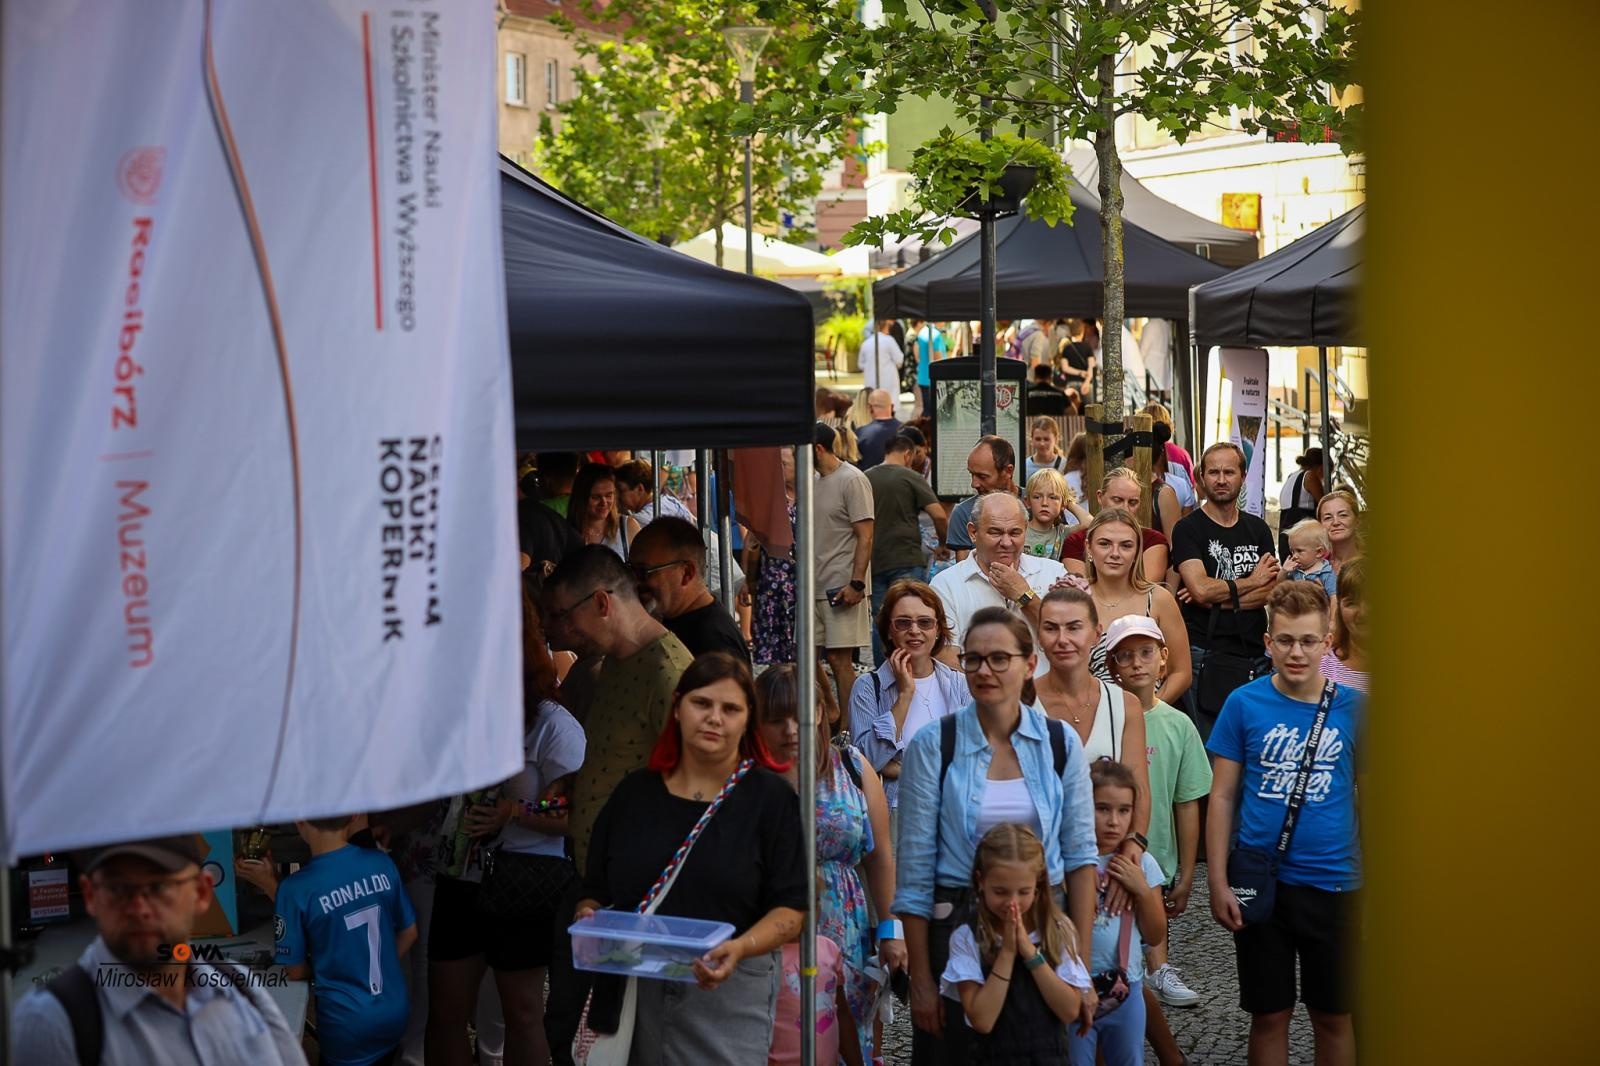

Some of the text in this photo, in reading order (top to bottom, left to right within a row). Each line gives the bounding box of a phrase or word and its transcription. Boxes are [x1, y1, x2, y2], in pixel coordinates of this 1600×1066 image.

[391, 25, 416, 184] Szkolnictwa
[421, 11, 442, 208] Minister Nauki
[394, 192, 419, 332] Wyższego
[111, 216, 154, 668] Racibórz Muzeum
[408, 437, 428, 560] NAUKI
[379, 438, 405, 643] KOPERNIK
[1233, 552, 1260, 564] DAD
[1234, 563, 1258, 573] EVE
[319, 873, 391, 914] RONALDO
[343, 903, 383, 995] 7
